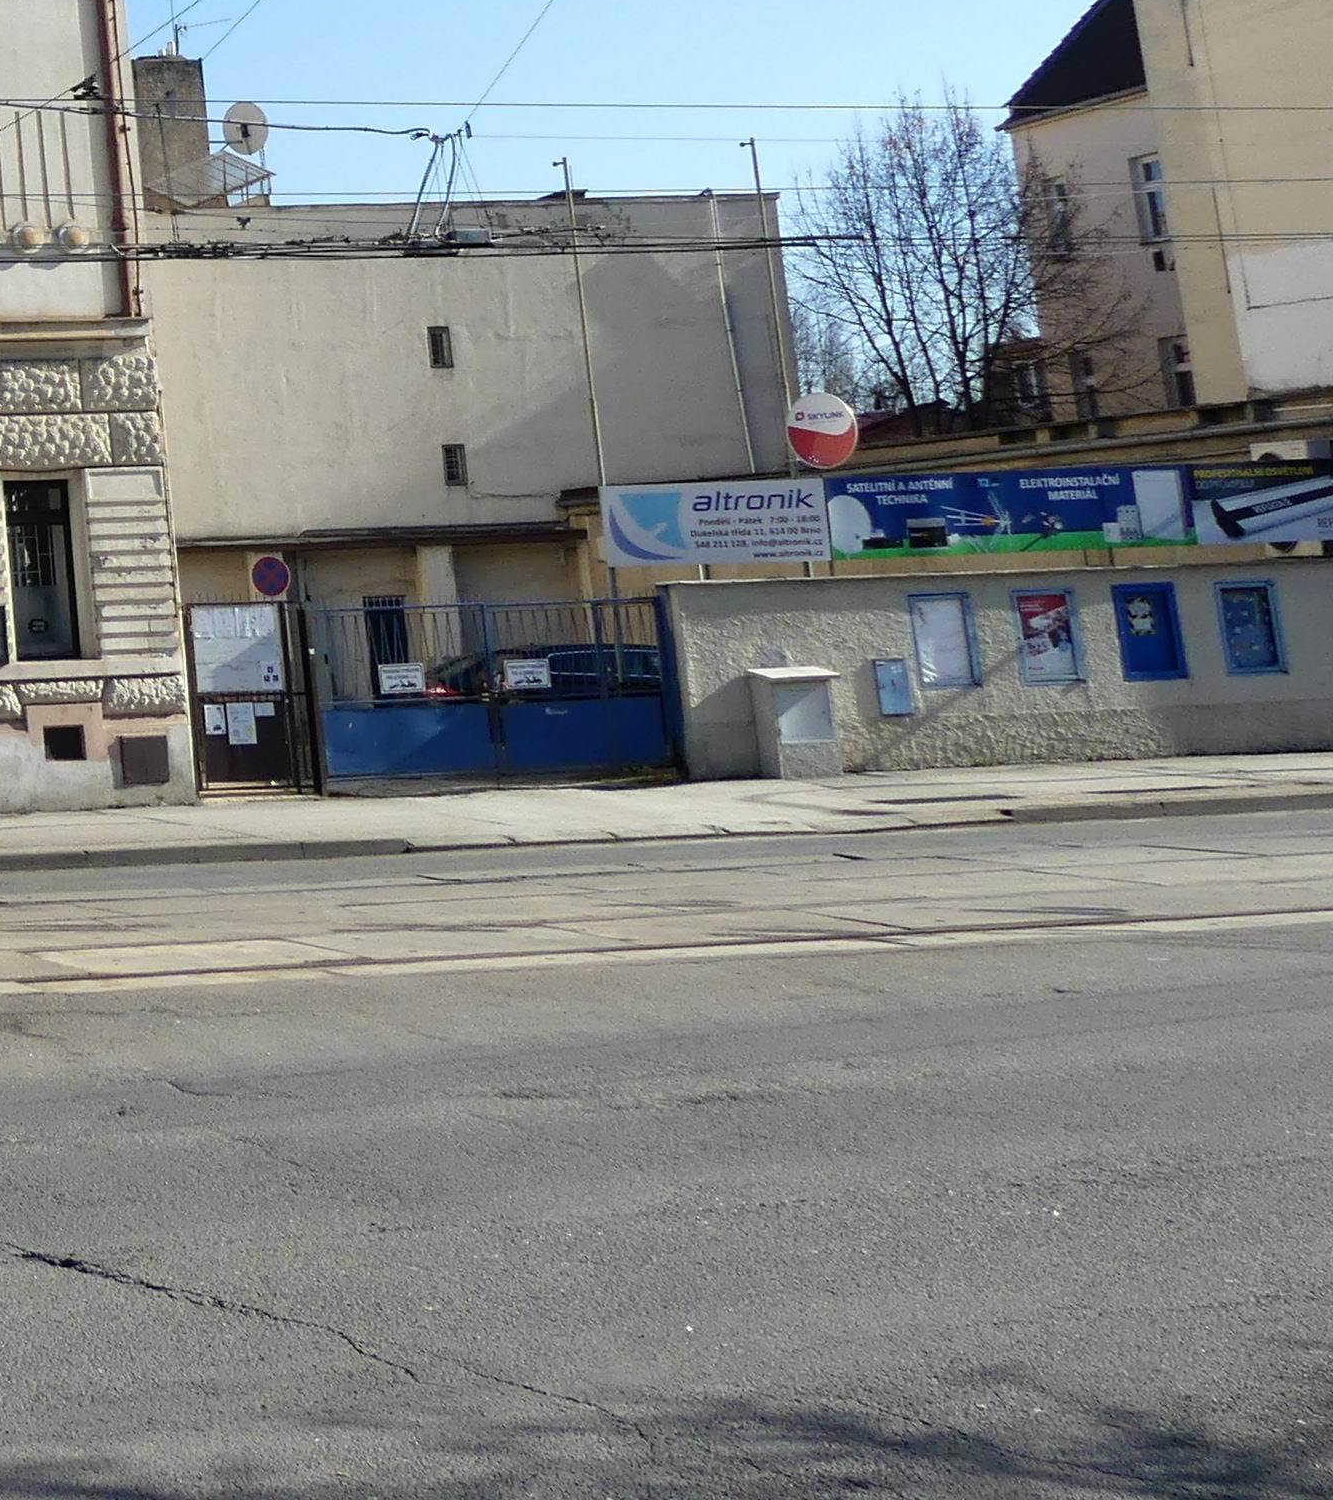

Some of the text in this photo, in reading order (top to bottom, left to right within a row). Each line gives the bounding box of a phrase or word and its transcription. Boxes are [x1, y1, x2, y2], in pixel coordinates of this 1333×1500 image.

[808, 411, 844, 420] SKYLINK
[846, 479, 895, 494] SATELITNÍ
[897, 482, 906, 491] A
[1019, 473, 1120, 489] ELEKTROINSTALAČNÍ
[692, 488, 814, 512] altronik
[875, 493, 928, 506] TECHNIKA
[1047, 488, 1099, 501] MATERIÁL
[769, 516, 788, 524] 7:00
[800, 526, 822, 534] Brno
